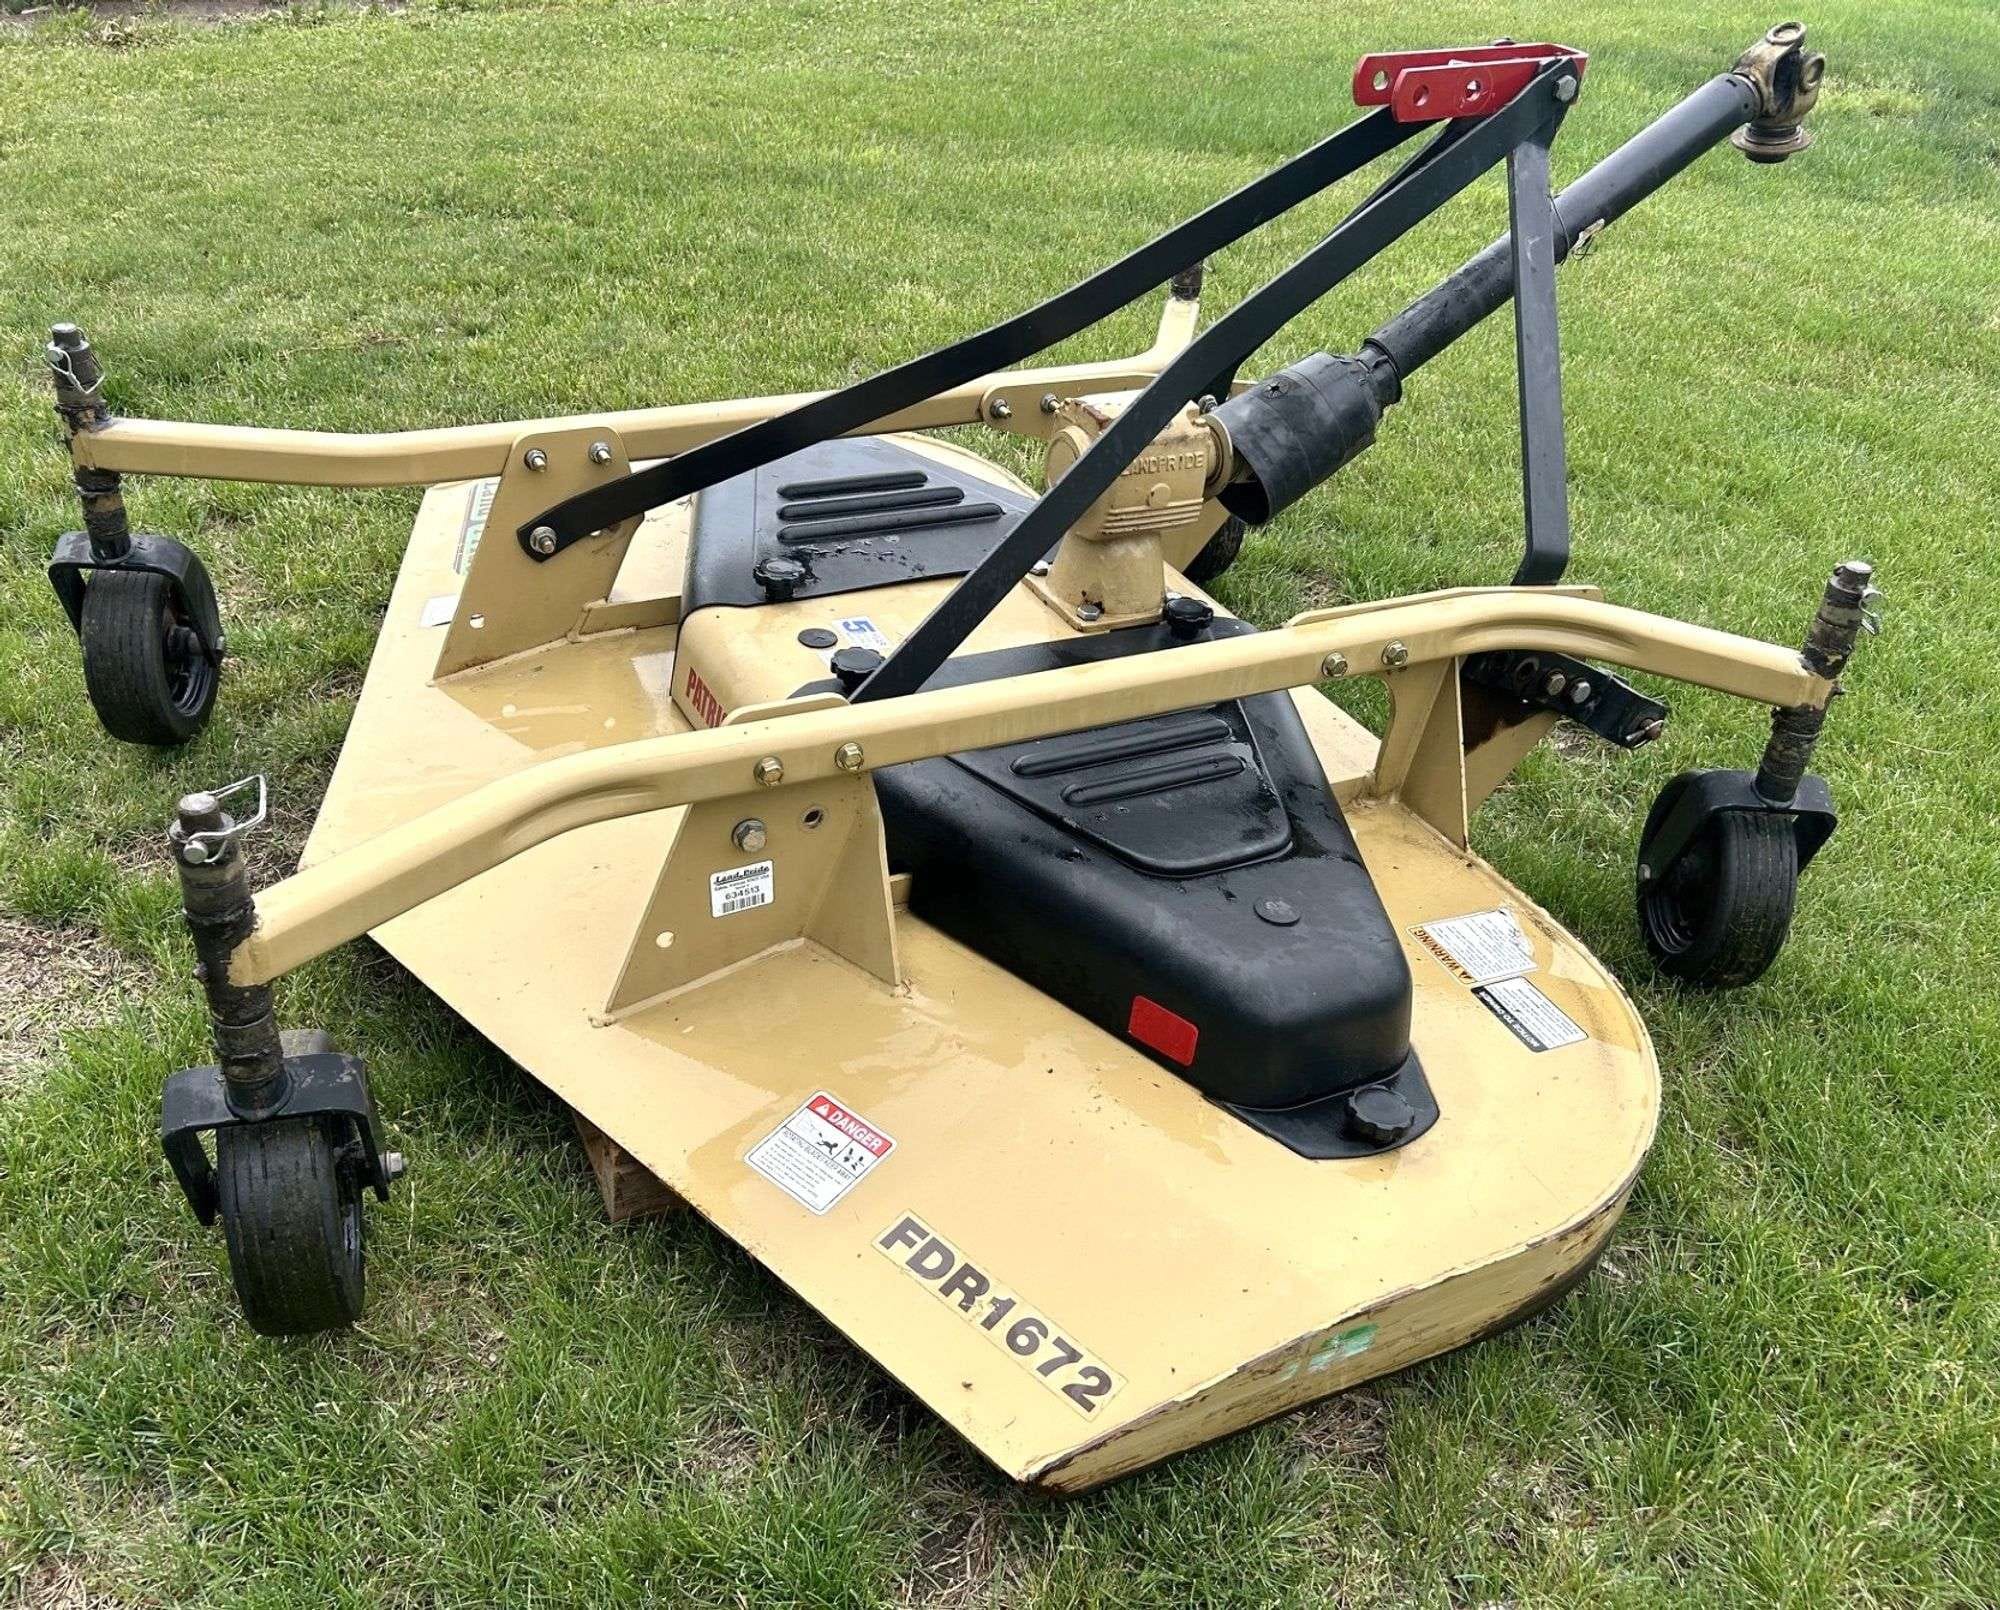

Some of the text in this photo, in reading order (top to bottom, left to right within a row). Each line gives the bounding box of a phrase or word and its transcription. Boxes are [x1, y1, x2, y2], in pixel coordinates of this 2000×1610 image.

[686, 667, 728, 728] PATRI
[1413, 929, 1460, 971] WARNING
[827, 1110, 883, 1150] DANGER
[879, 1216, 1112, 1413] FDR1672
